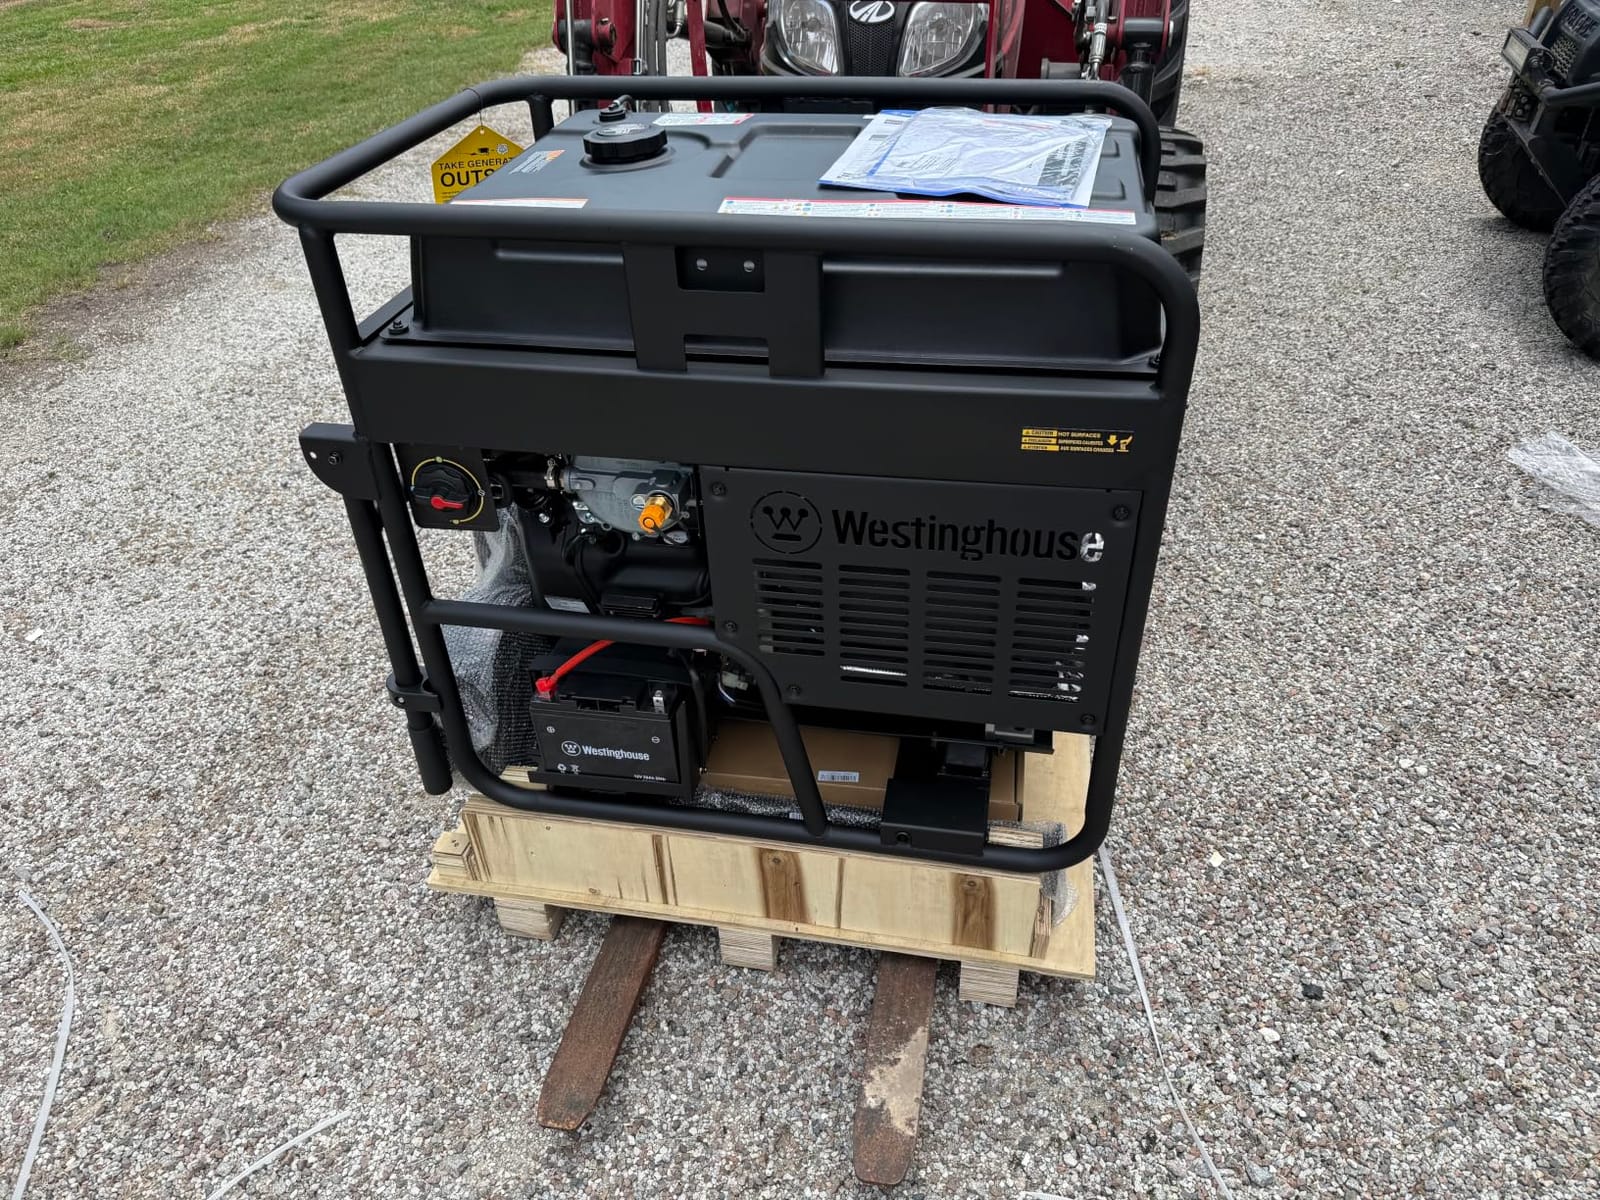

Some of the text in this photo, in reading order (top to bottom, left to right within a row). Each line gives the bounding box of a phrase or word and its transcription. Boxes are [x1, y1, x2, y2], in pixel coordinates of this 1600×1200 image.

[438, 161, 465, 170] TAKE
[832, 509, 1105, 563] Westinghouse
[581, 744, 650, 761] Westinghouse
